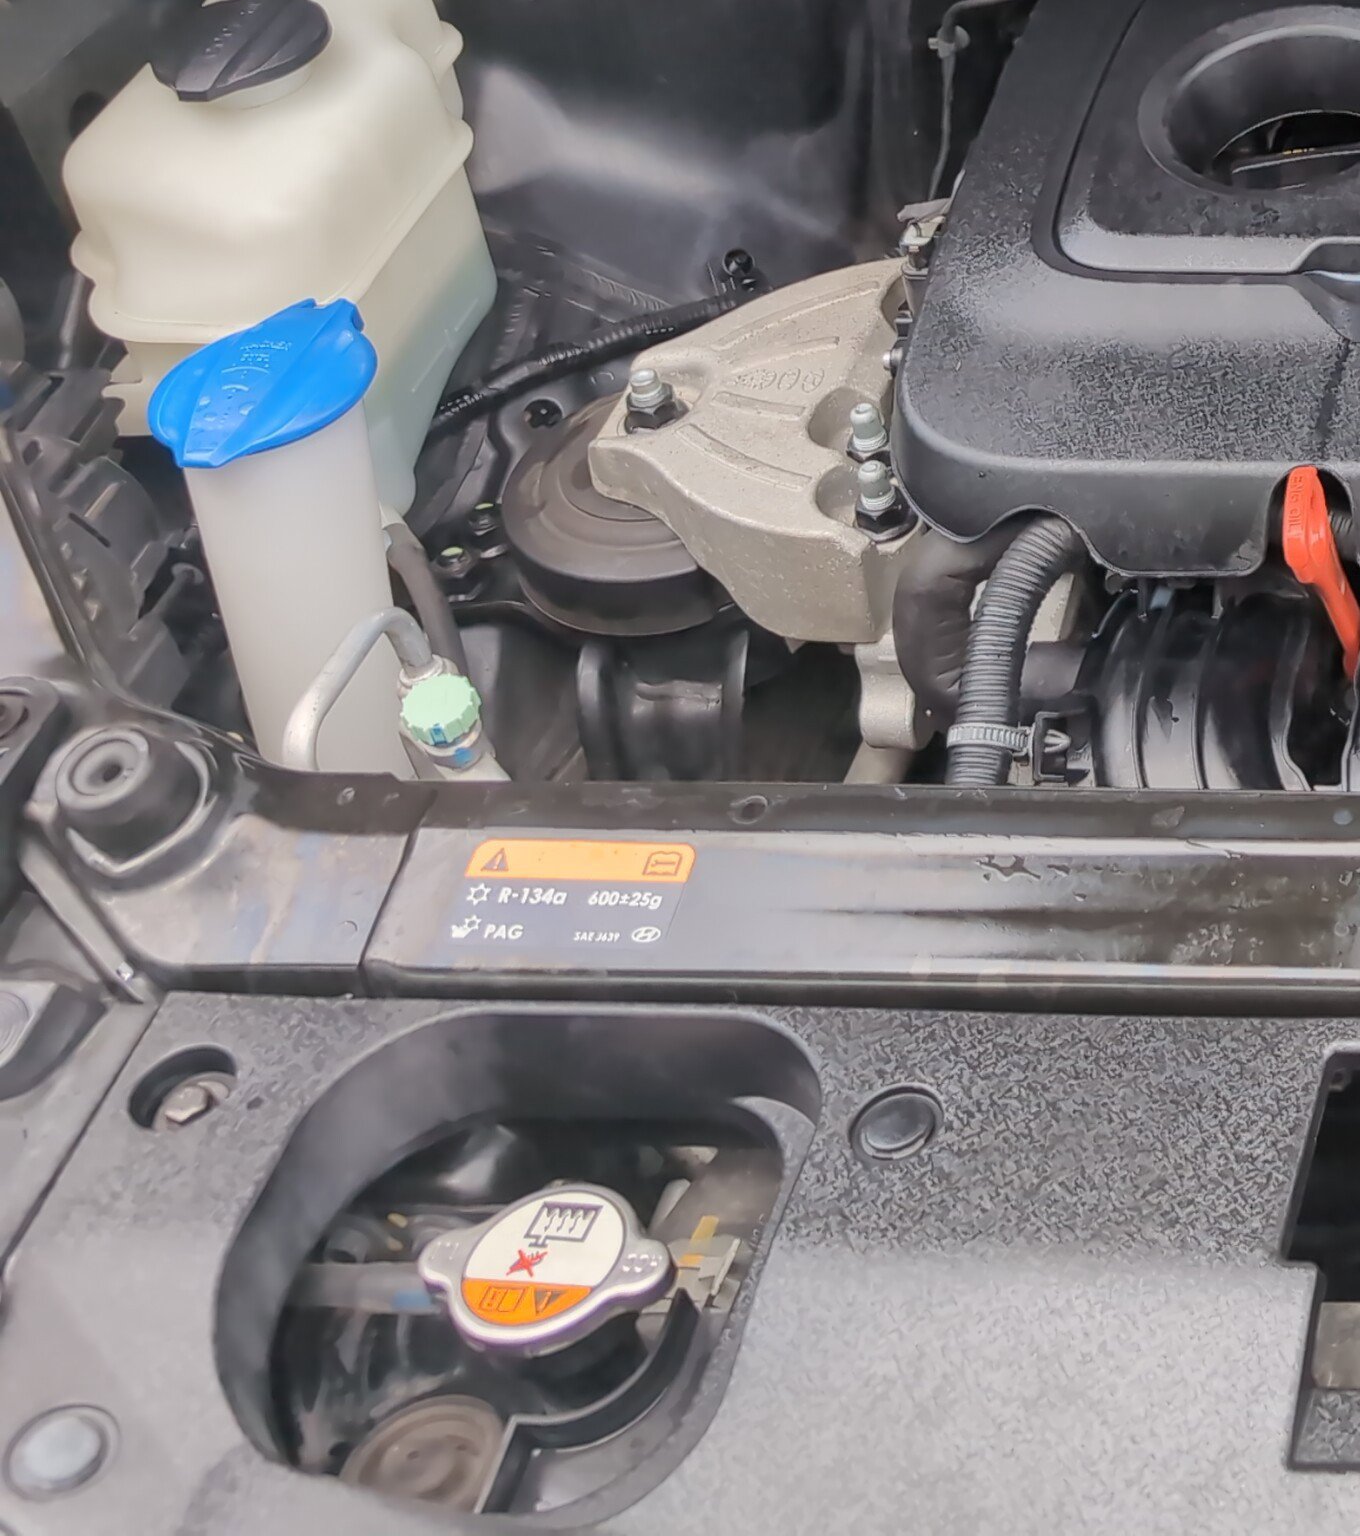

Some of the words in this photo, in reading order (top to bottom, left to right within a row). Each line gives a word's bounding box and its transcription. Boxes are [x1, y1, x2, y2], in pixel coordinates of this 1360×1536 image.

[1290, 476, 1304, 502] ENG
[498, 887, 567, 905] R-134a
[588, 891, 663, 910] 600±25g
[483, 924, 524, 940] PAG
